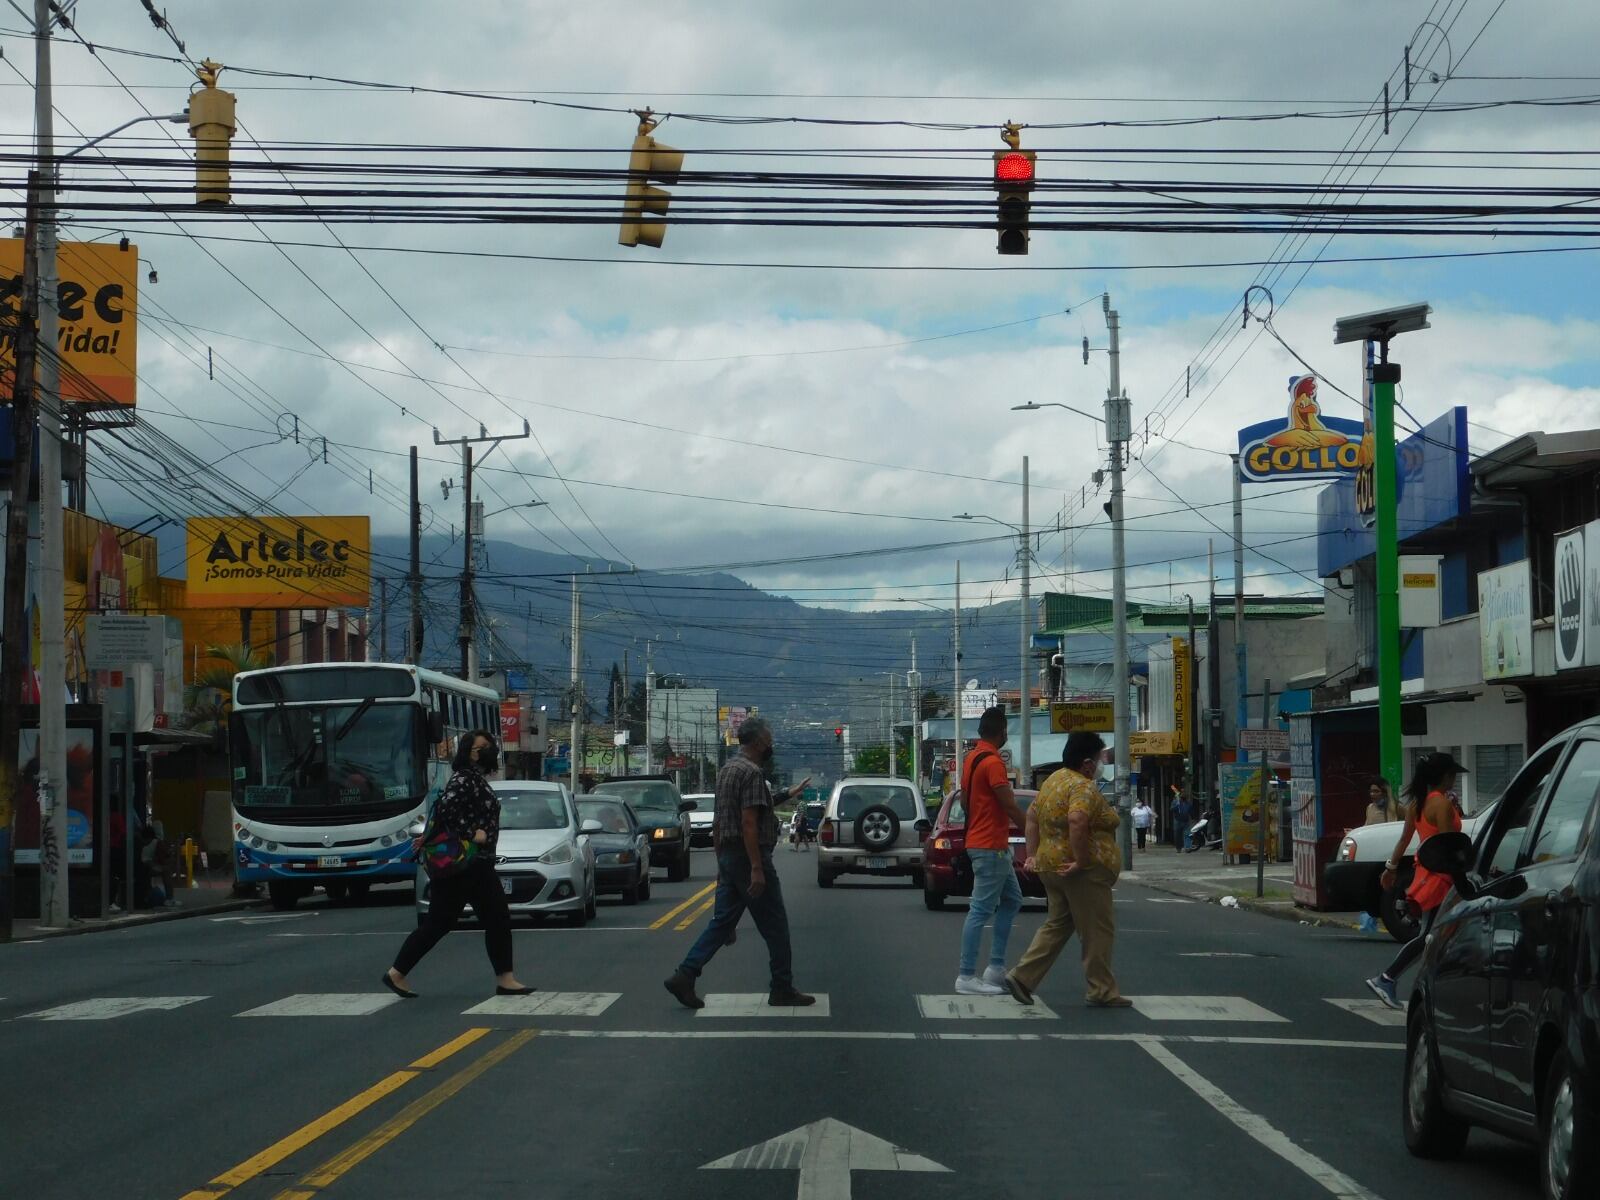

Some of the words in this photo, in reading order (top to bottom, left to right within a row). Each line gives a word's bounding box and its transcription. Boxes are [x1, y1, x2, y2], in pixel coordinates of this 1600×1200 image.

[58, 326, 120, 354] ida!
[1249, 443, 1361, 472] GOLLO
[206, 528, 349, 564] Artelec
[205, 564, 263, 582] ¡Somos
[266, 564, 303, 578] Pura
[307, 563, 348, 578] Vida!
[1561, 616, 1580, 631] ADOC
[1054, 702, 1111, 711] CERRAJERIA
[1175, 654, 1185, 751] CERRAJERIA
